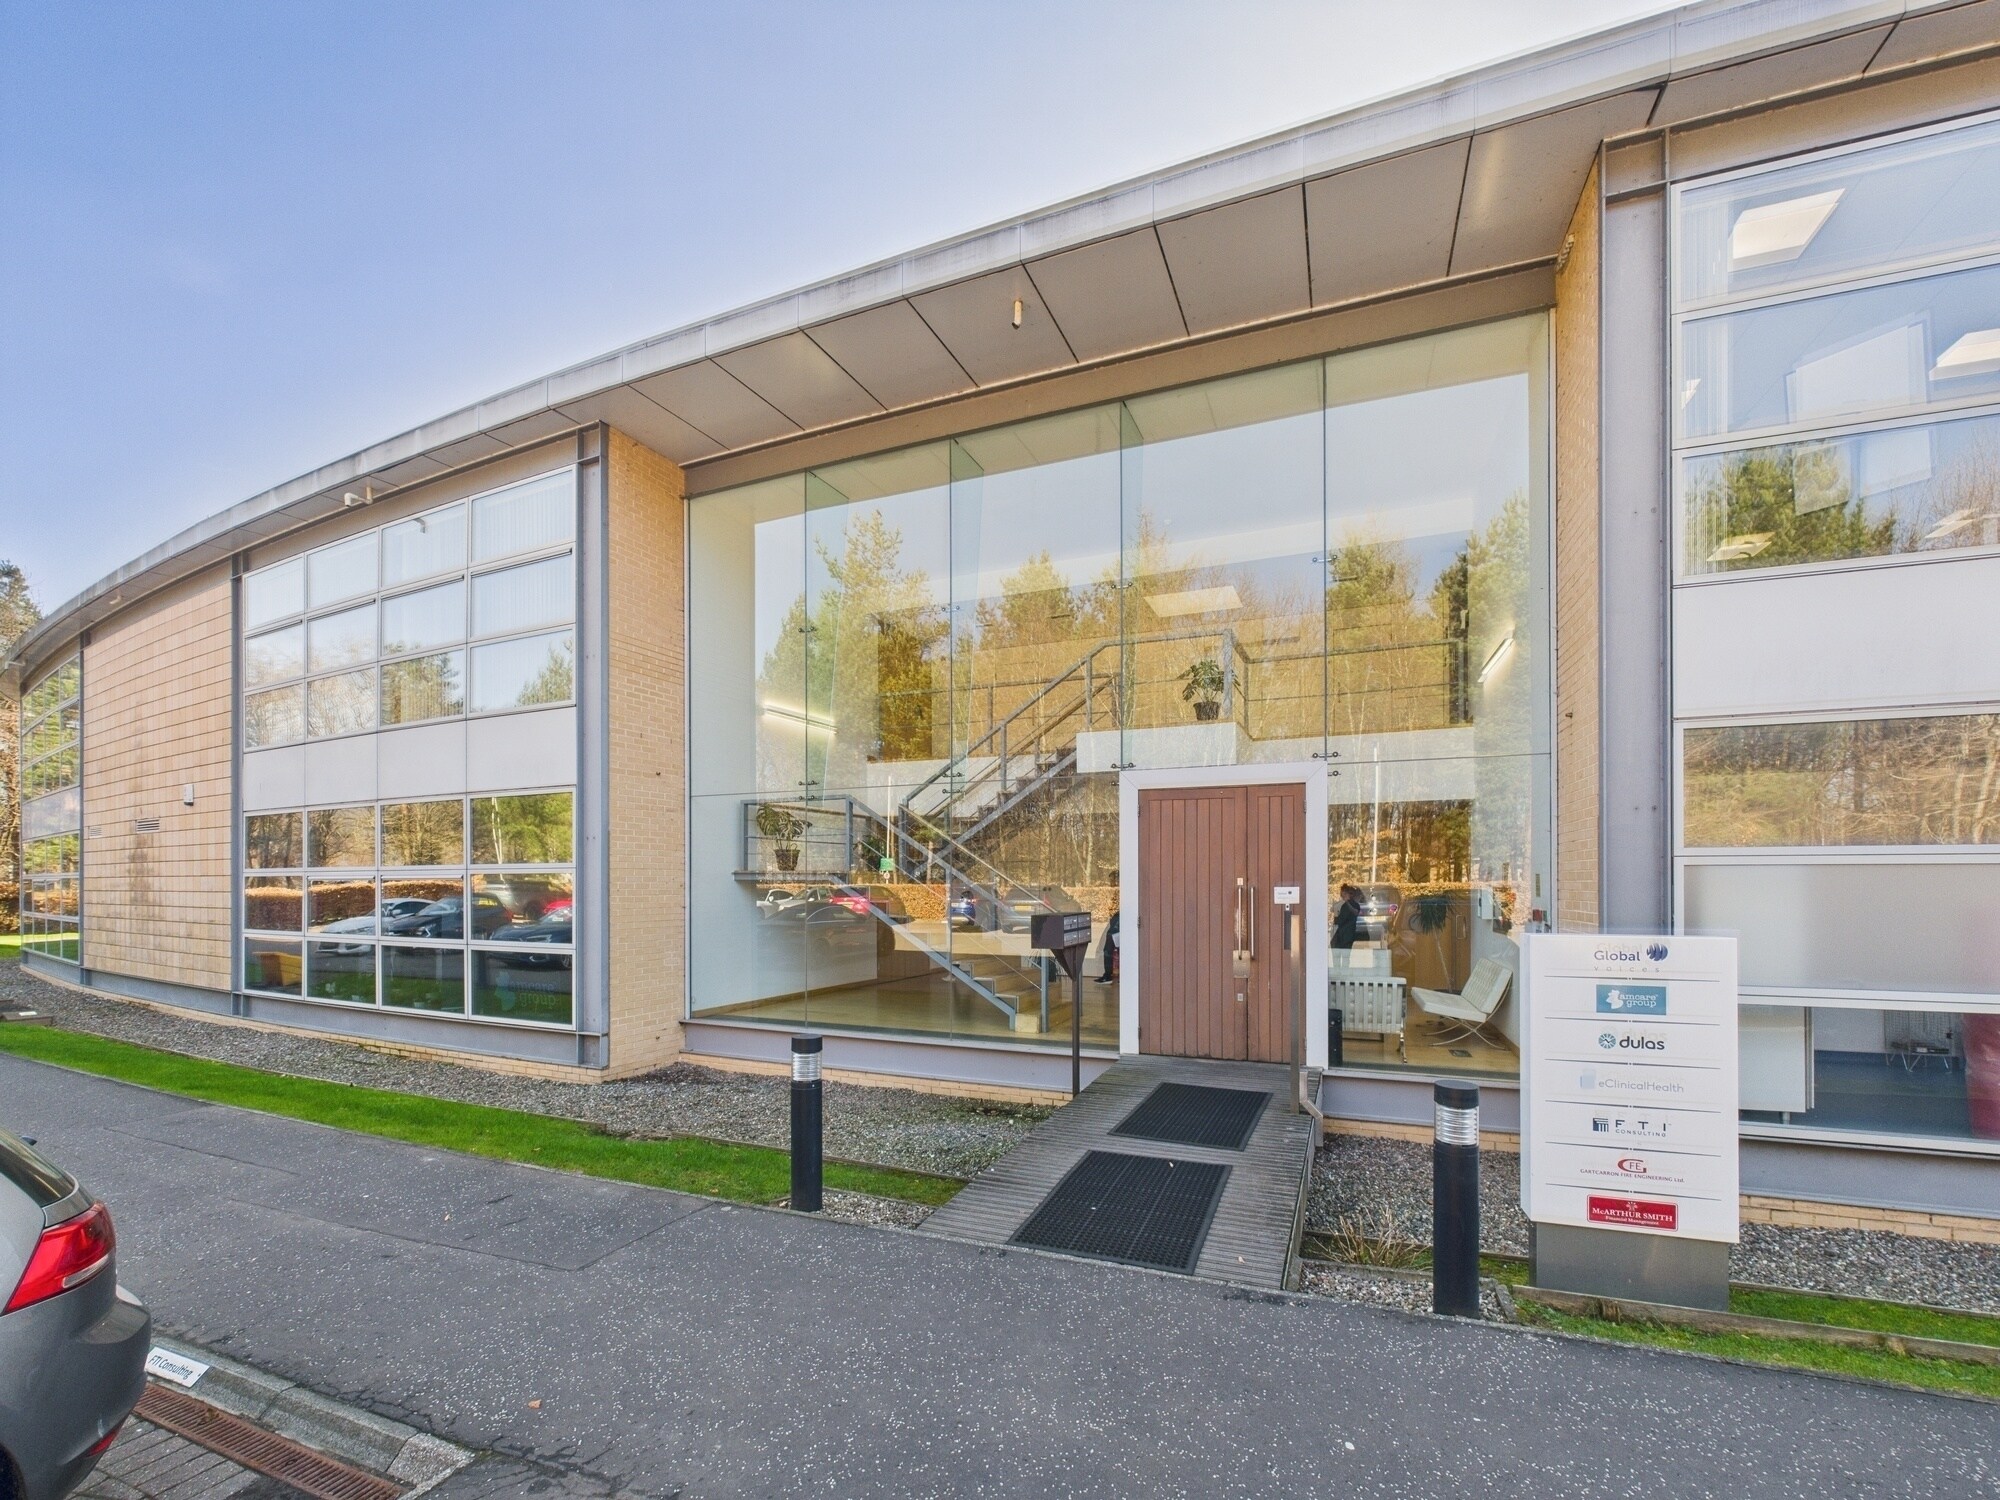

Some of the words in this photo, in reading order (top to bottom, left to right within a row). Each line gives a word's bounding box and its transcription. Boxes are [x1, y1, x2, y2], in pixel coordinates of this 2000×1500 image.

[1594, 950, 1640, 961] Global
[519, 993, 556, 1009] group
[1626, 1000, 1657, 1008] group
[1619, 1036, 1665, 1050] dulas
[1598, 1079, 1684, 1092] eClinicalHealth
[1615, 1129, 1666, 1138] CONSULTING
[1634, 1174, 1673, 1182] ENGINEERING
[1592, 1207, 1642, 1219] McARTHUR
[1643, 1212, 1673, 1222] SMITH
[1628, 1217, 1660, 1226] Management
[148, 1355, 163, 1367] FTI
[158, 1359, 193, 1380] Consulting
